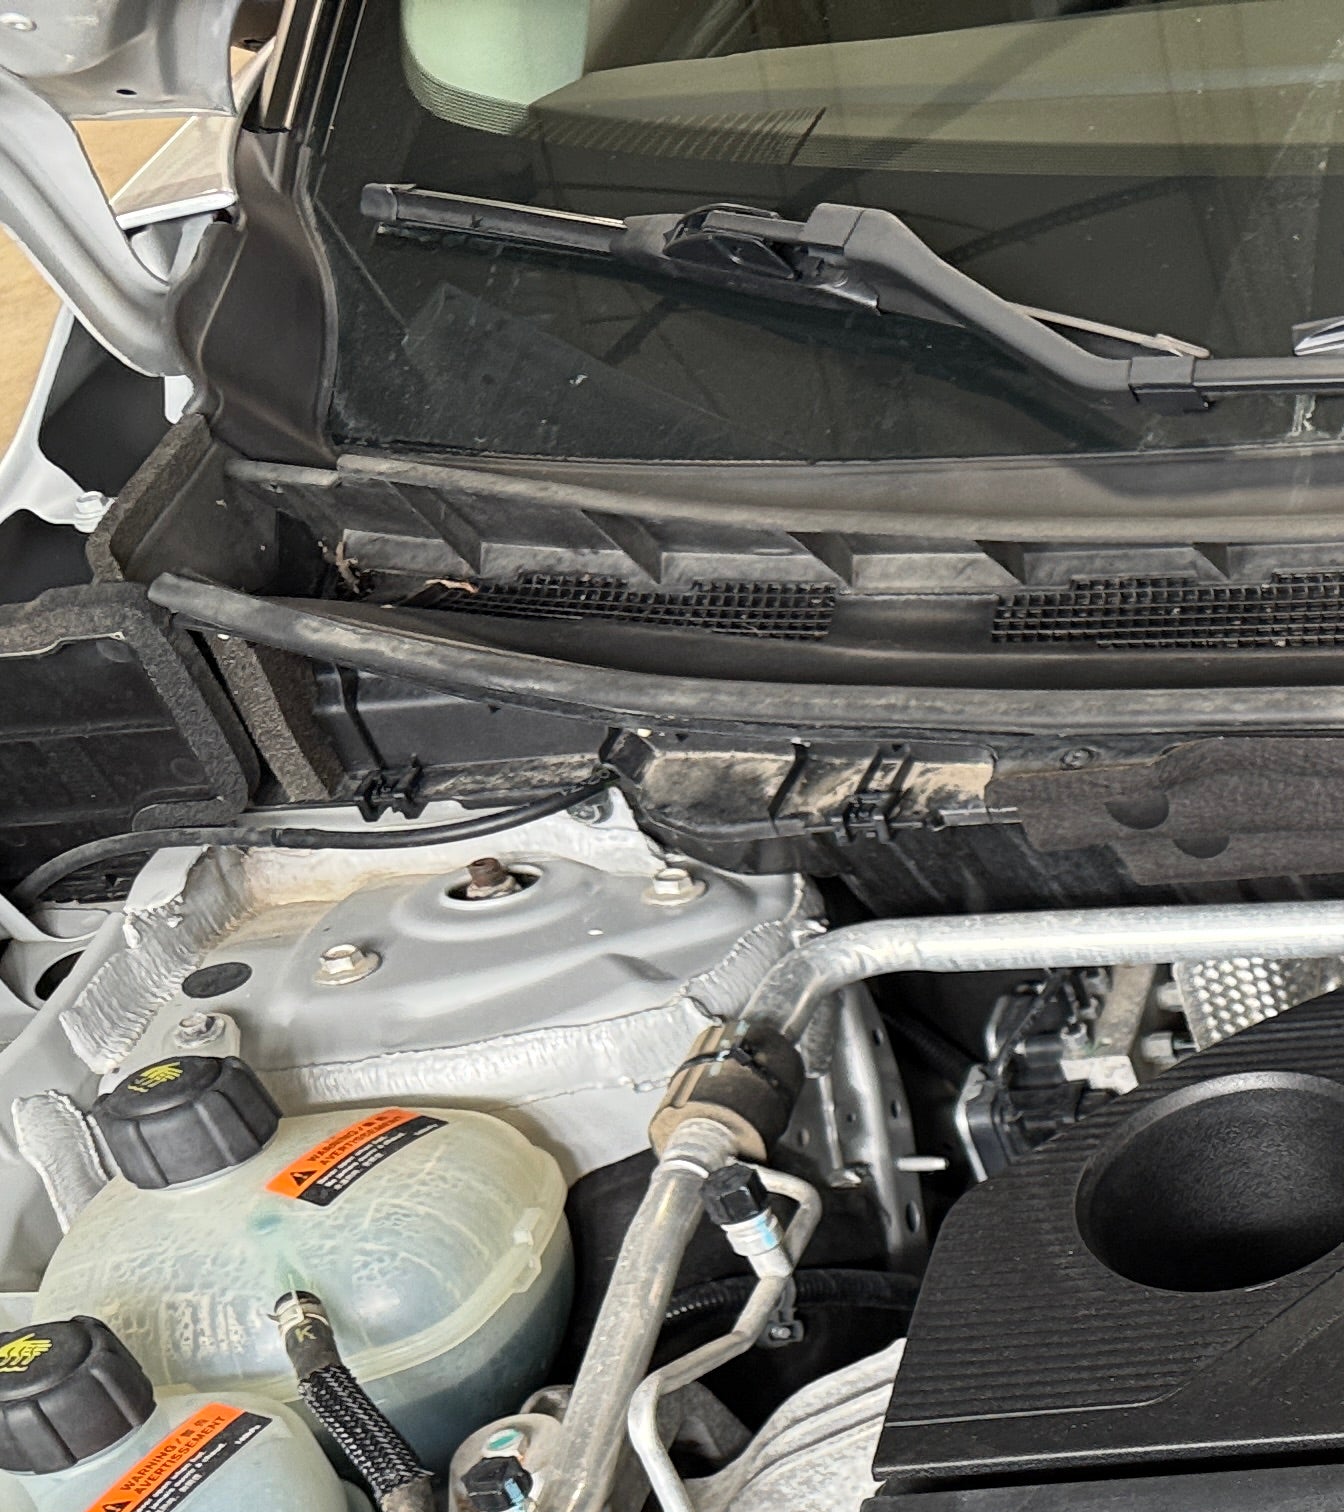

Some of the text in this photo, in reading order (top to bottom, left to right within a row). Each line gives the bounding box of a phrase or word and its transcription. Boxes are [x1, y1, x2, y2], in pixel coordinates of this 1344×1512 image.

[295, 1325, 317, 1343] K
[120, 1445, 178, 1491] WARNING
[134, 1415, 226, 1495] AVERTISSEMENT
